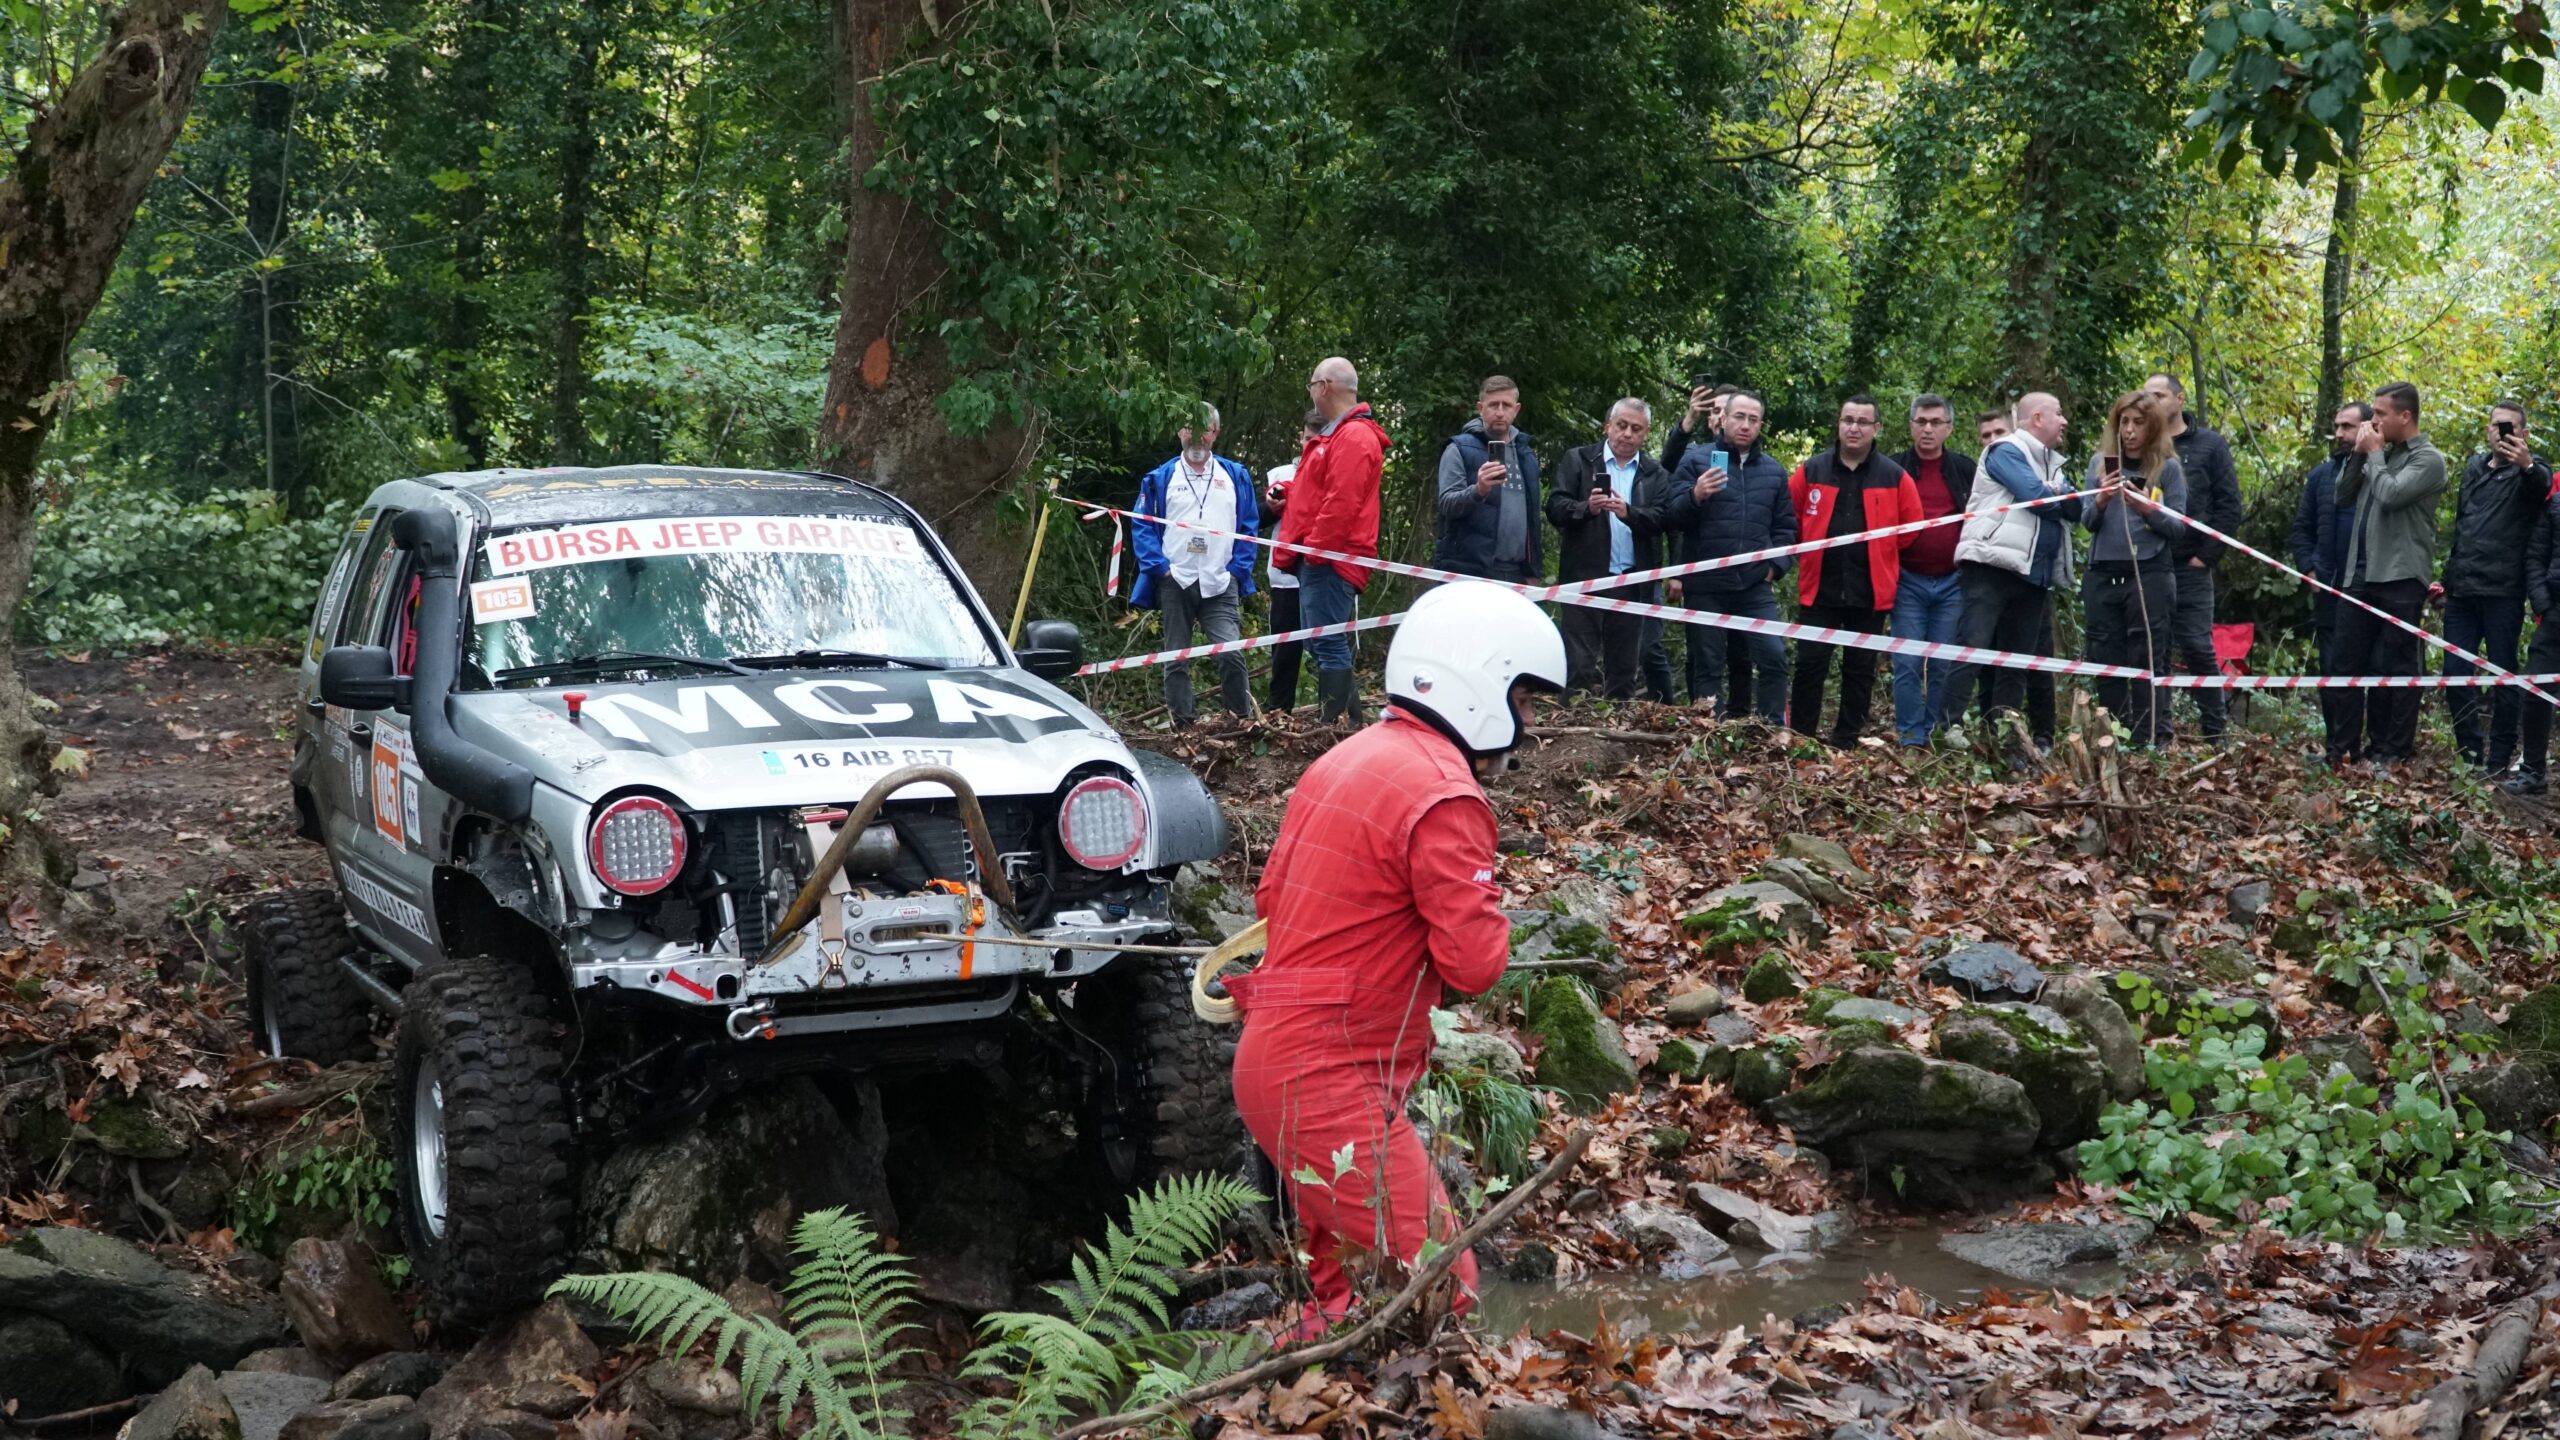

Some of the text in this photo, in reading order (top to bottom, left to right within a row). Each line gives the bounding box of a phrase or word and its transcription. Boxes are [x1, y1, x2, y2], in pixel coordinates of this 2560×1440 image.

[501, 520, 912, 567] BURSA JEEP GARAGE
[482, 589, 523, 609] 105
[582, 679, 1069, 742] MCA
[793, 752, 831, 768] 16
[842, 750, 895, 767] AIB
[902, 749, 954, 766] 857
[375, 759, 398, 826] 105
